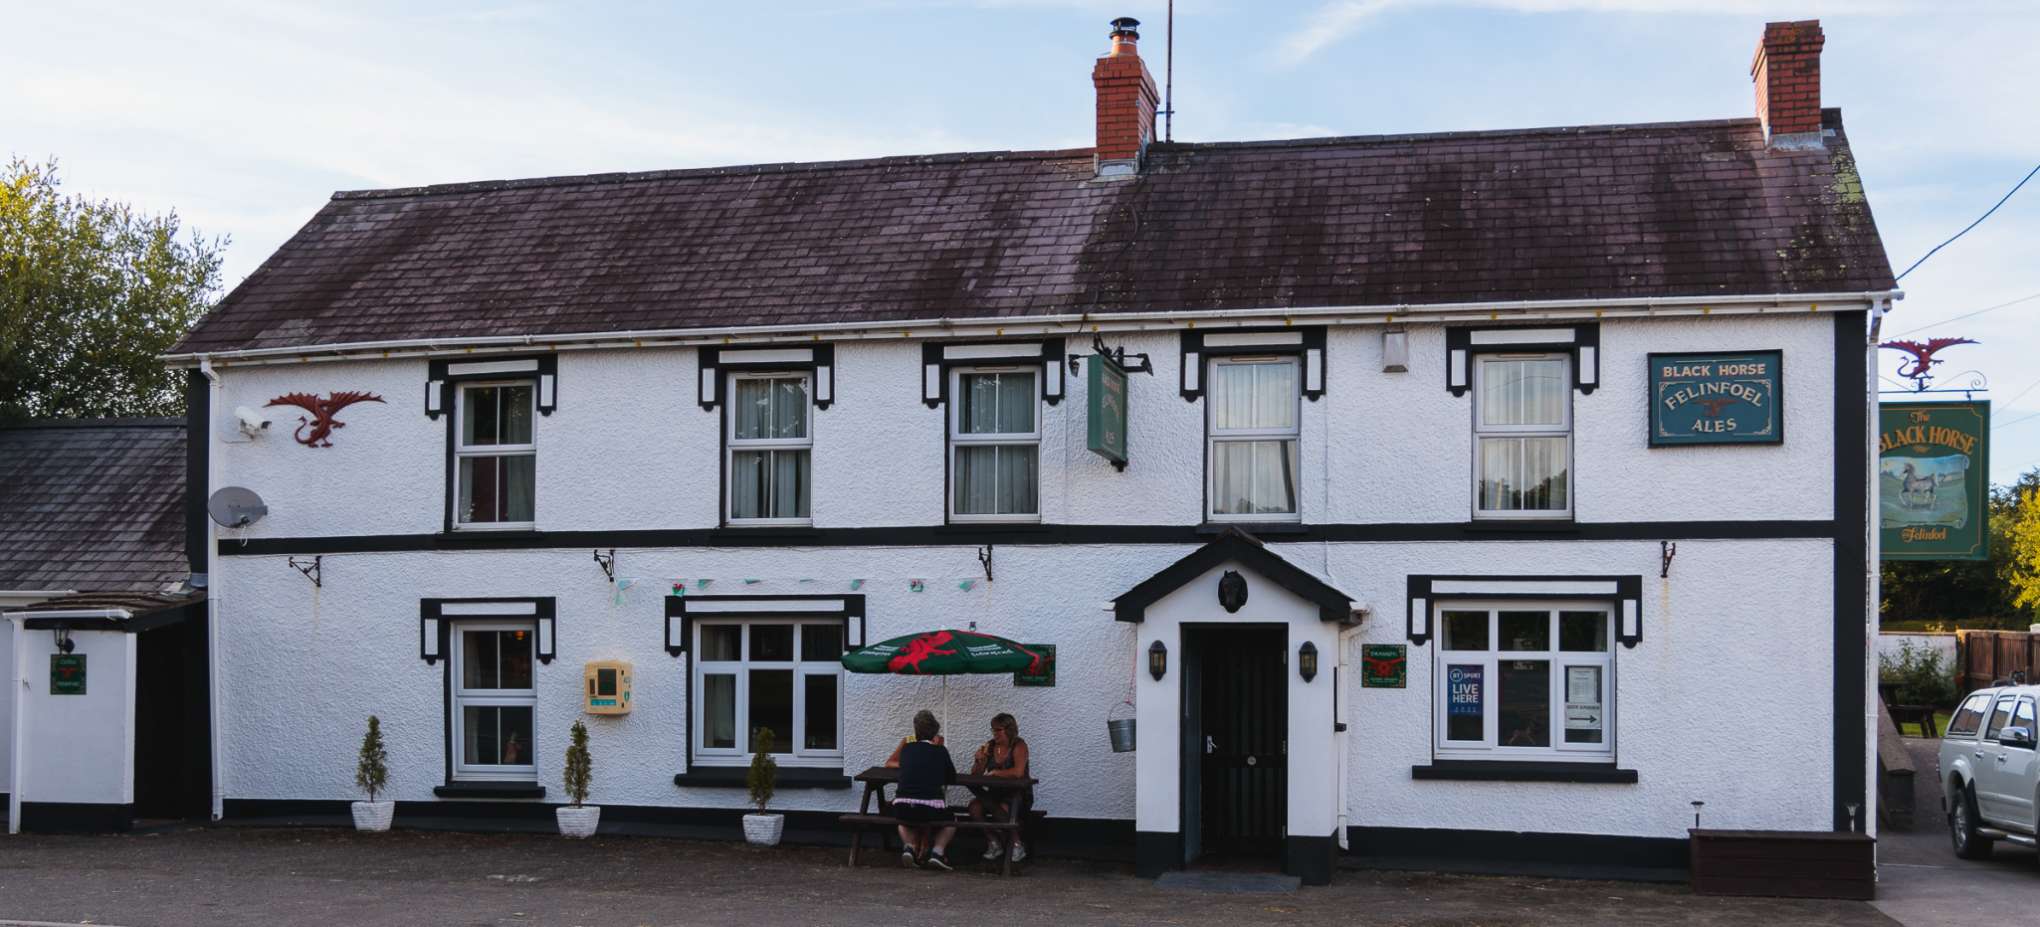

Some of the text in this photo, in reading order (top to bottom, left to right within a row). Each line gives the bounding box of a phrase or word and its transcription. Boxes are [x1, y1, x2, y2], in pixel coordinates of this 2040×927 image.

[1663, 363, 1766, 378] BLACK HORSE
[1664, 381, 1763, 411] FELINFOEL
[1691, 417, 1737, 433] ALES
[1928, 425, 1977, 455] HORSE
[1452, 683, 1479, 694] LIVE
[1452, 694, 1479, 703] HERE
